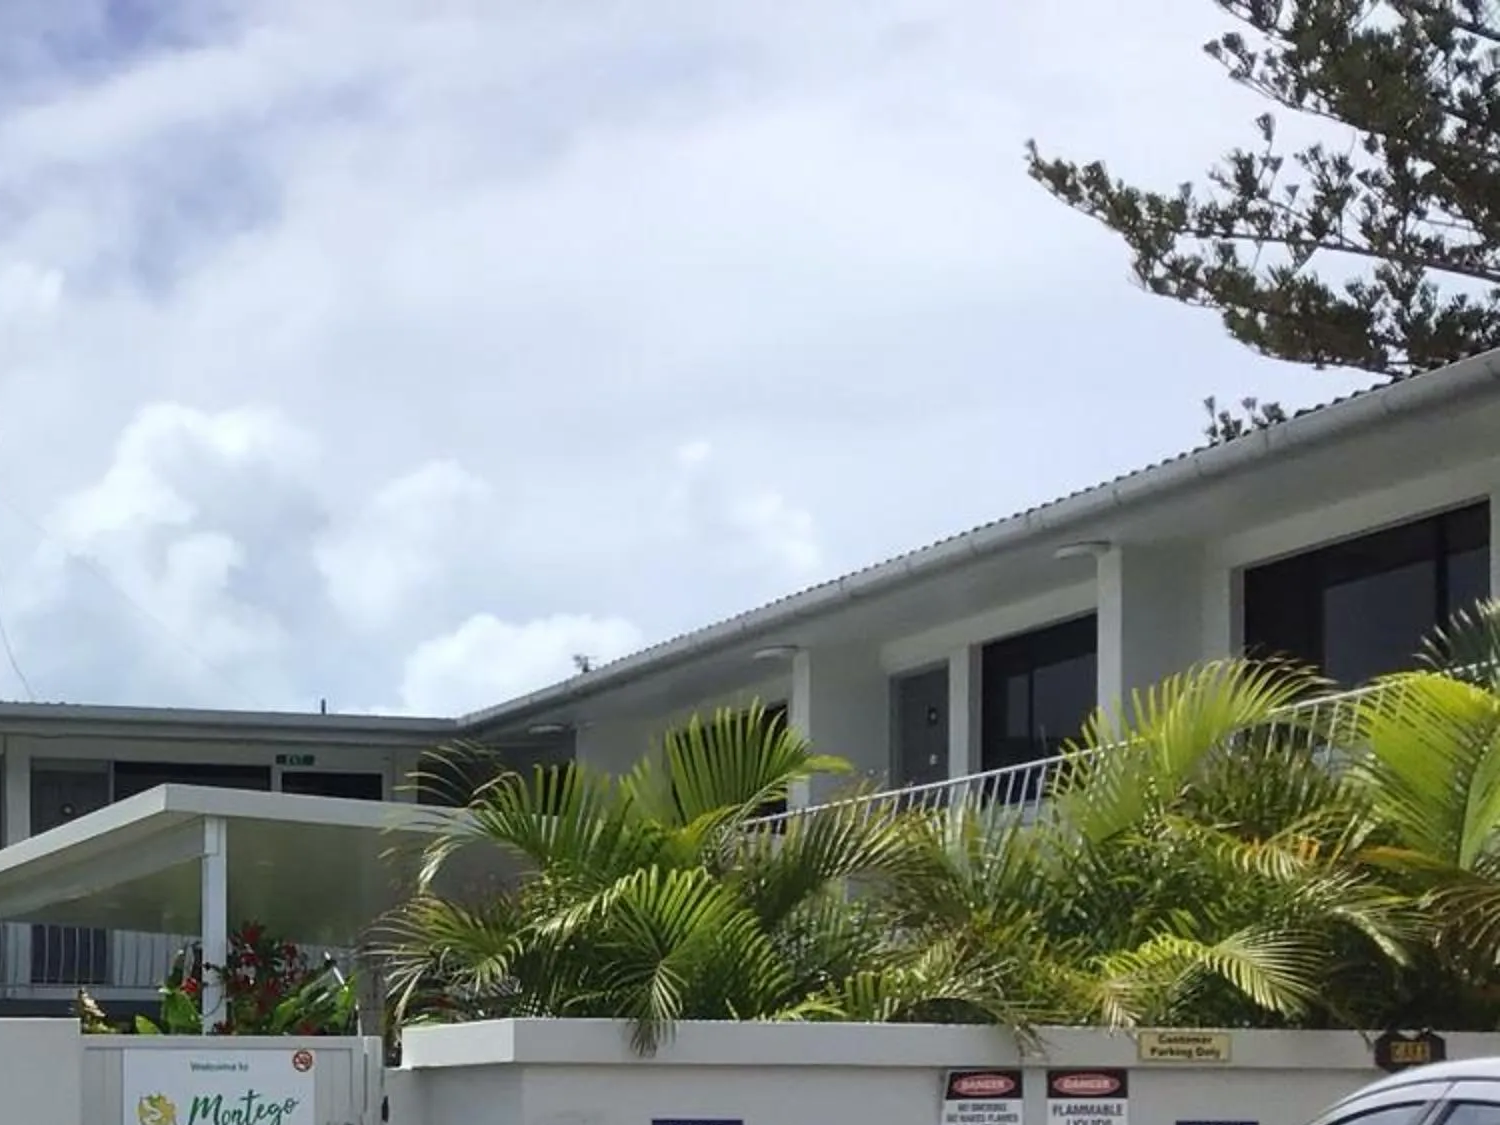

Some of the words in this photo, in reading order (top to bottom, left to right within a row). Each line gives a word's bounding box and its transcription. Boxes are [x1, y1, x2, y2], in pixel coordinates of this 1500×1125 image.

[1150, 1047, 1192, 1058] Parking
[1195, 1046, 1220, 1058] Only
[961, 1079, 1005, 1088] DANGER
[1063, 1079, 1110, 1088] DANGER
[1052, 1104, 1124, 1116] FLAMMABLE
